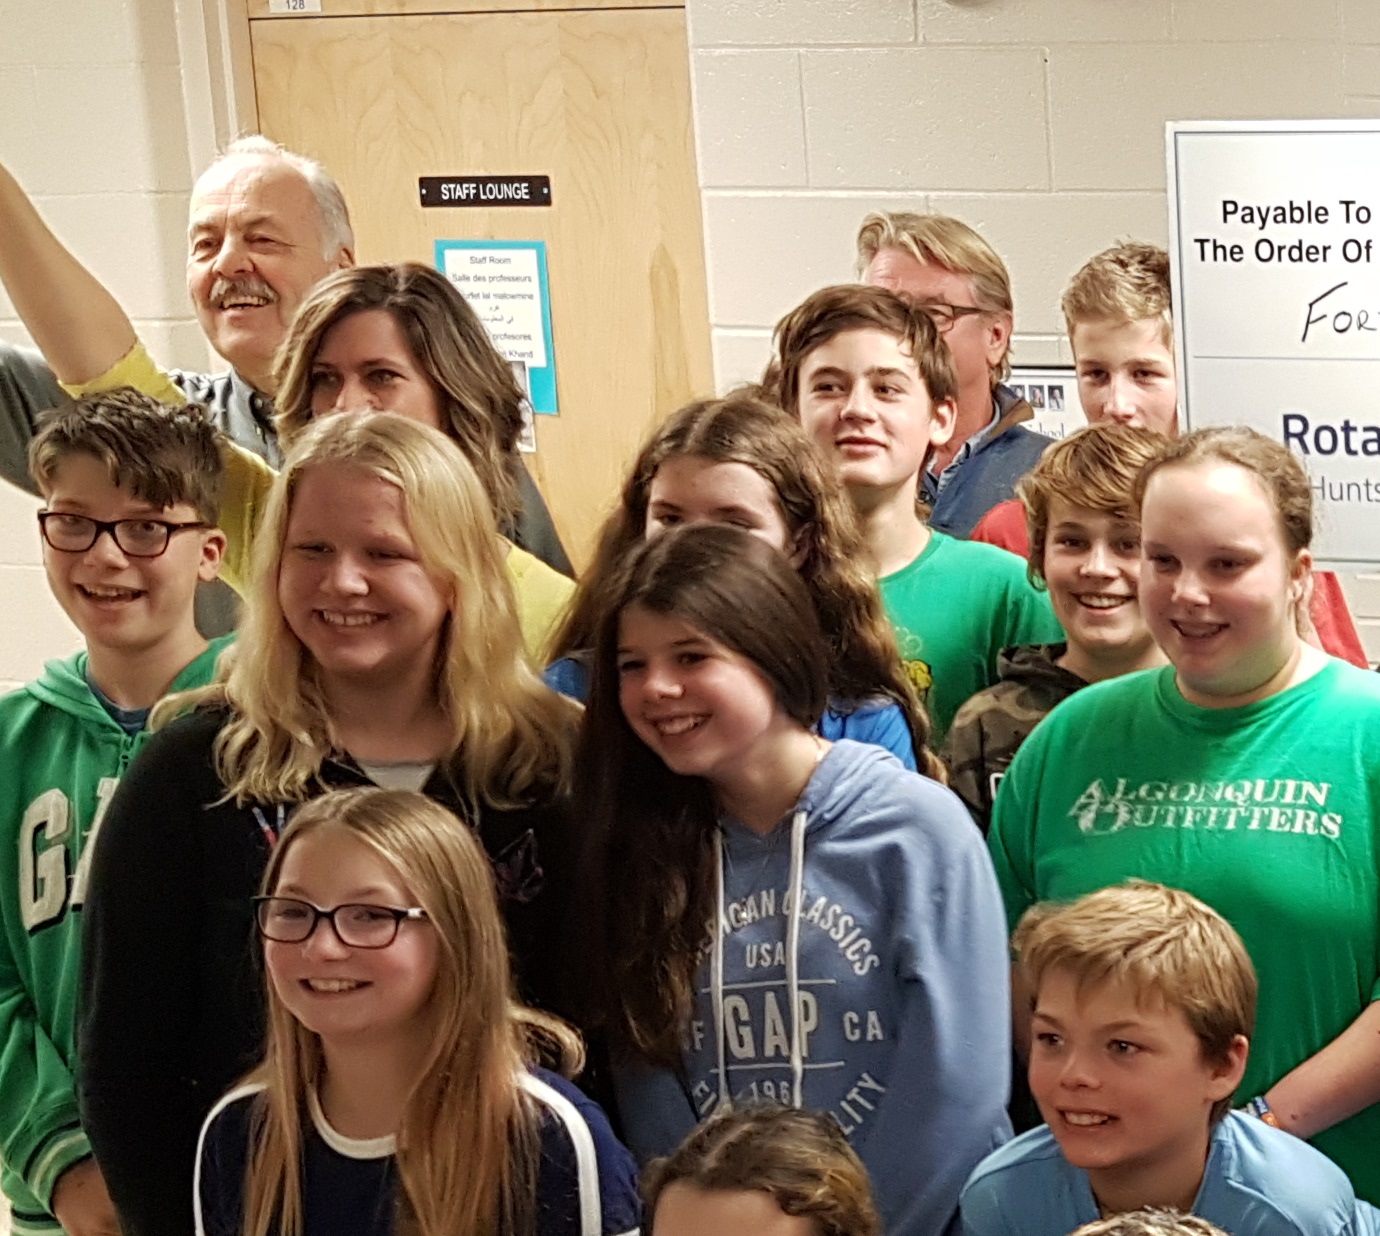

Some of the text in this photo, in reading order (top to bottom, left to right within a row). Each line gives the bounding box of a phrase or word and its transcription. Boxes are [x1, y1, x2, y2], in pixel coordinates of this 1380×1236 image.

[441, 183, 530, 200] STAFF LOUNGE
[1222, 200, 1372, 230] Payable To
[1194, 238, 1244, 262] The
[1254, 238, 1332, 263] Order
[1342, 238, 1372, 263] Of
[1067, 777, 1331, 817] ALGONQUIN
[1078, 799, 1342, 839] OUTFITTERS
[746, 941, 785, 968] USA
[724, 991, 818, 1059] GAP
[749, 1080, 800, 1105] 196
